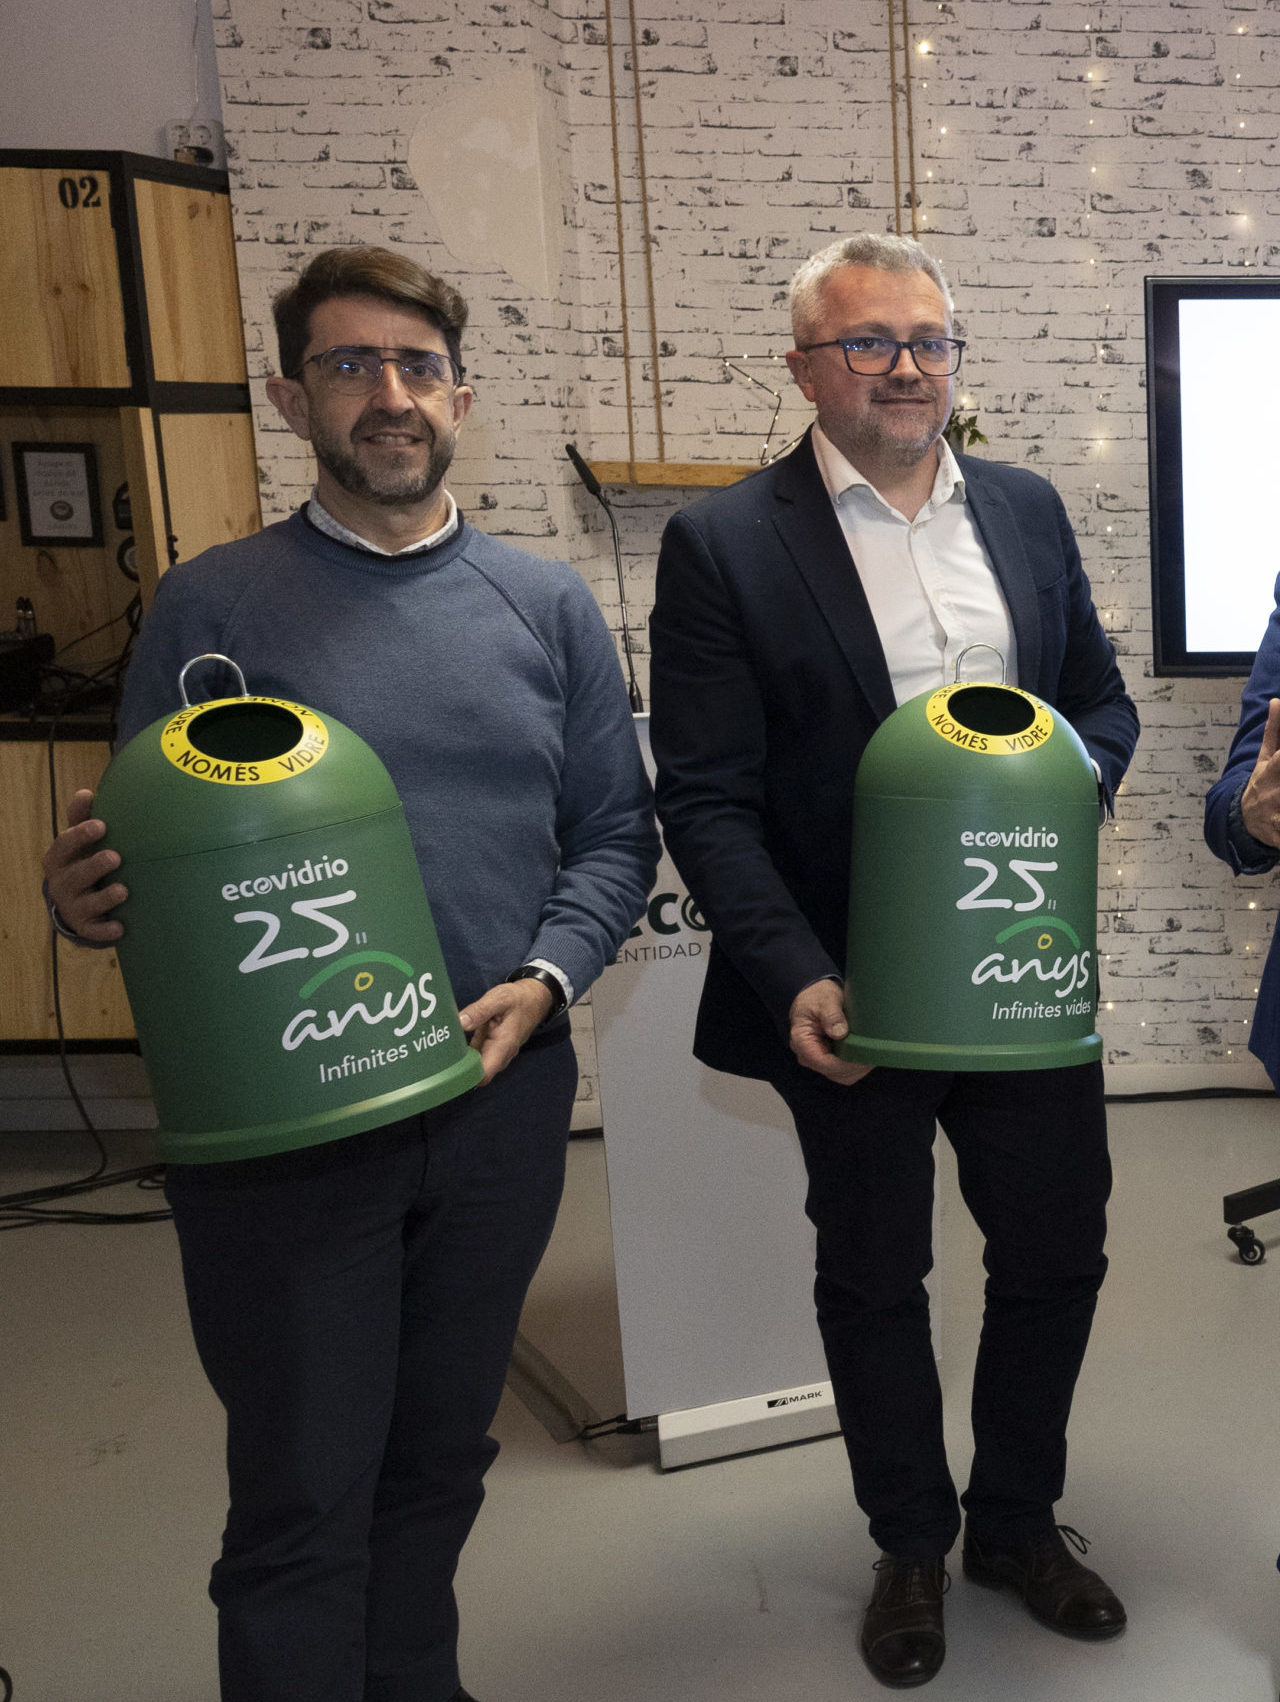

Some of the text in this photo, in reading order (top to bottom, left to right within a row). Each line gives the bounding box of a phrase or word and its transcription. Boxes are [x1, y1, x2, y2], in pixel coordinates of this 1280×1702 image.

[58, 175, 102, 209] 02
[931, 713, 1049, 752] NOMÉS VIDRE
[176, 734, 325, 782] NOMÉS VIDRE
[960, 826, 1059, 848] ecovidrio
[221, 855, 349, 901] ecovidrio
[956, 857, 1059, 912] 25
[233, 889, 357, 974] 25
[971, 950, 1091, 998] anys
[281, 972, 437, 1051] anys
[992, 997, 1091, 1020] Infinites vides
[319, 1024, 451, 1083] Infinites vides
[789, 1390, 823, 1403] MARK
